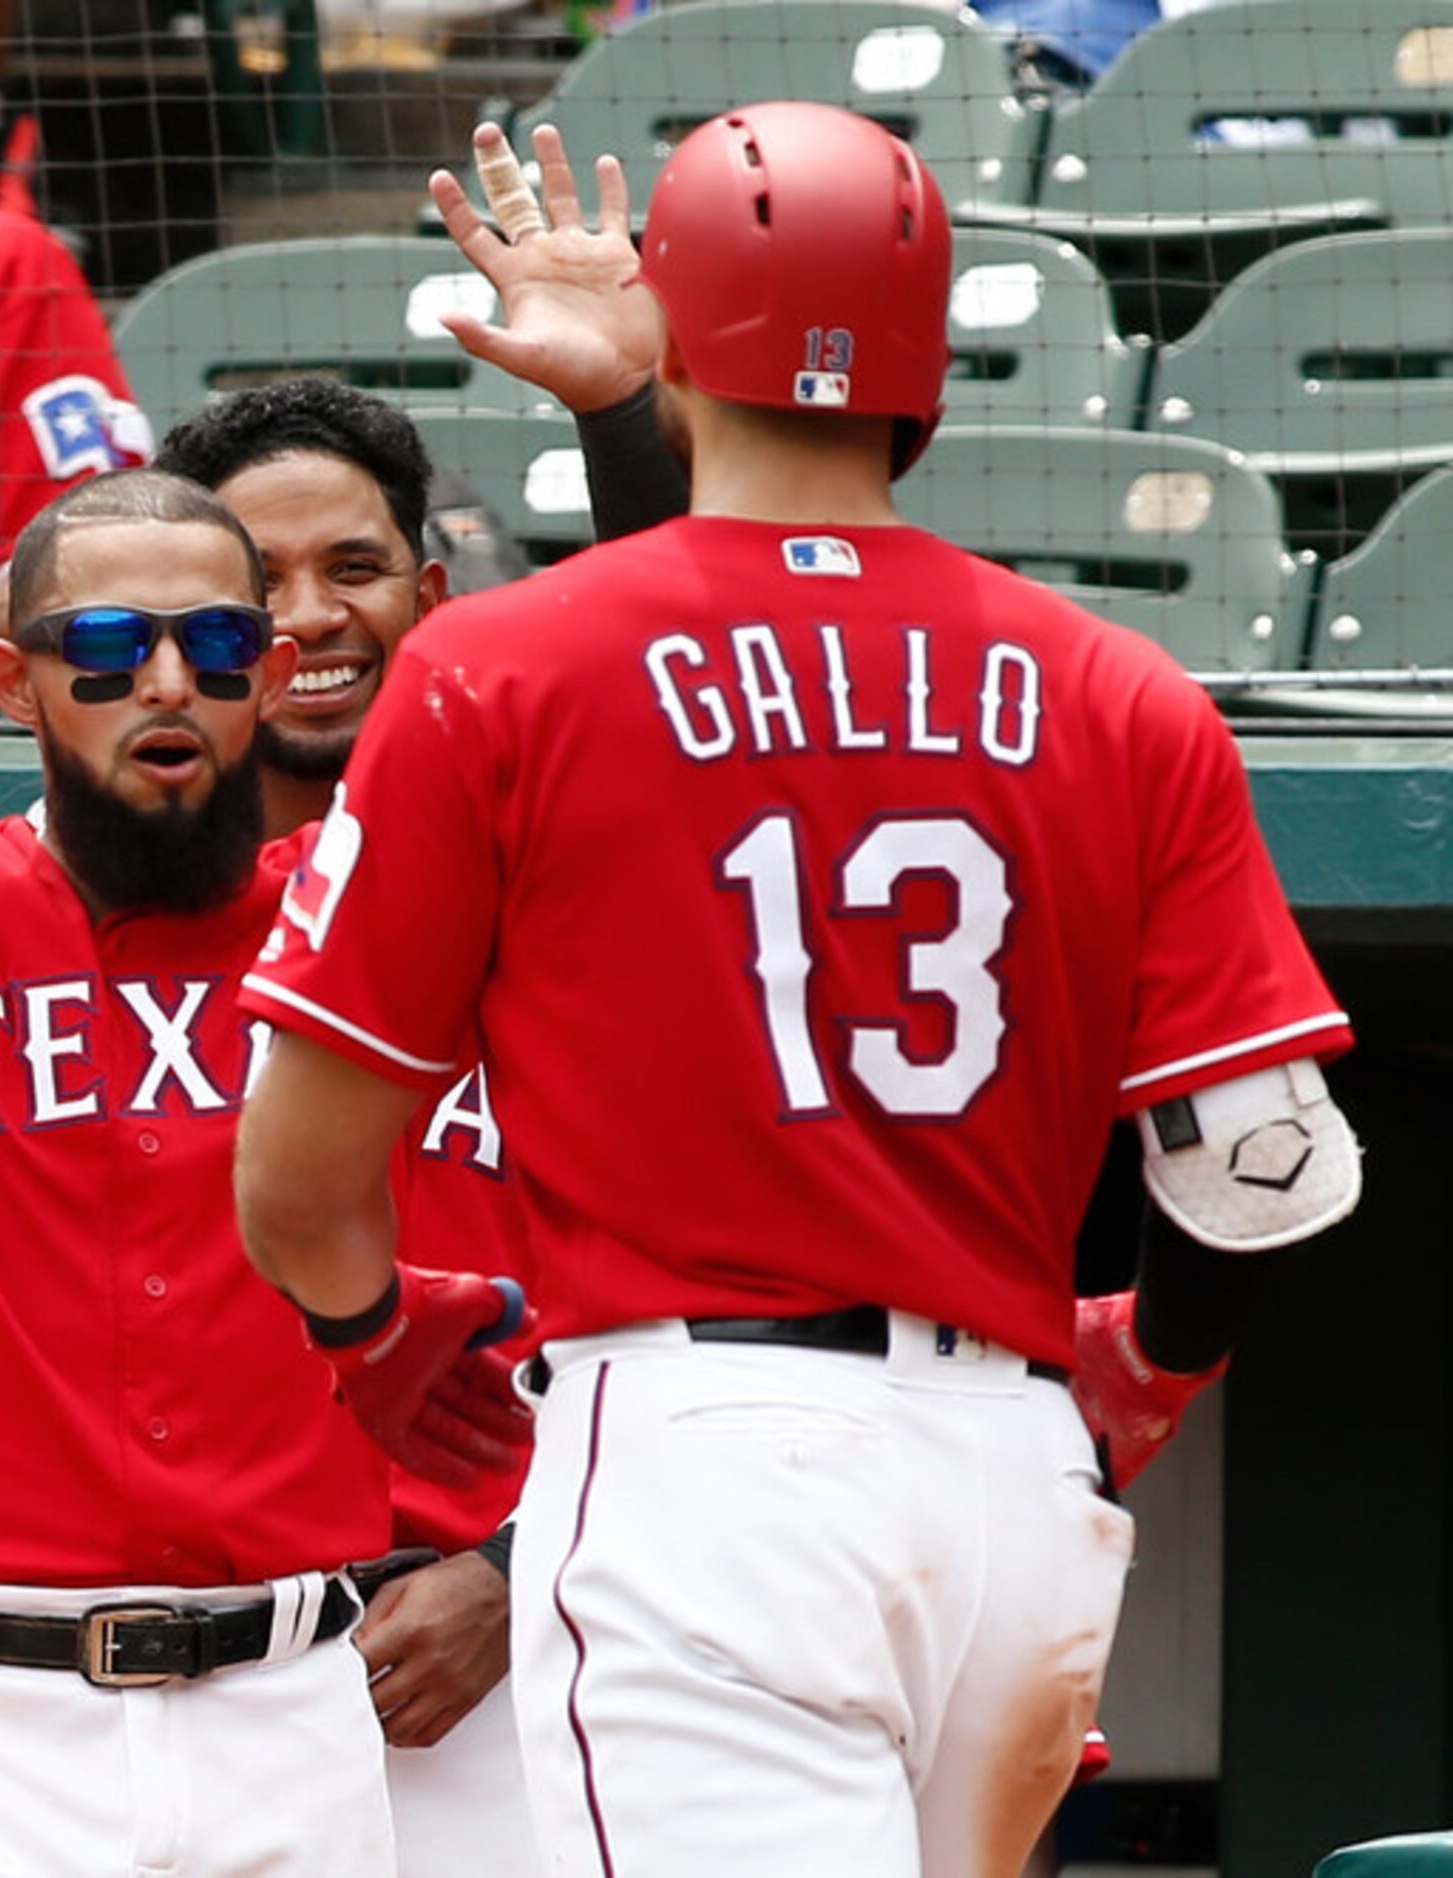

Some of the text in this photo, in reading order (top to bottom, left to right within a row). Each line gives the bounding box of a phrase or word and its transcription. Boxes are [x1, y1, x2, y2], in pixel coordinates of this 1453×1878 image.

[805, 326, 854, 370] 13
[644, 624, 1042, 767] GALLO
[714, 808, 1022, 1125] 13
